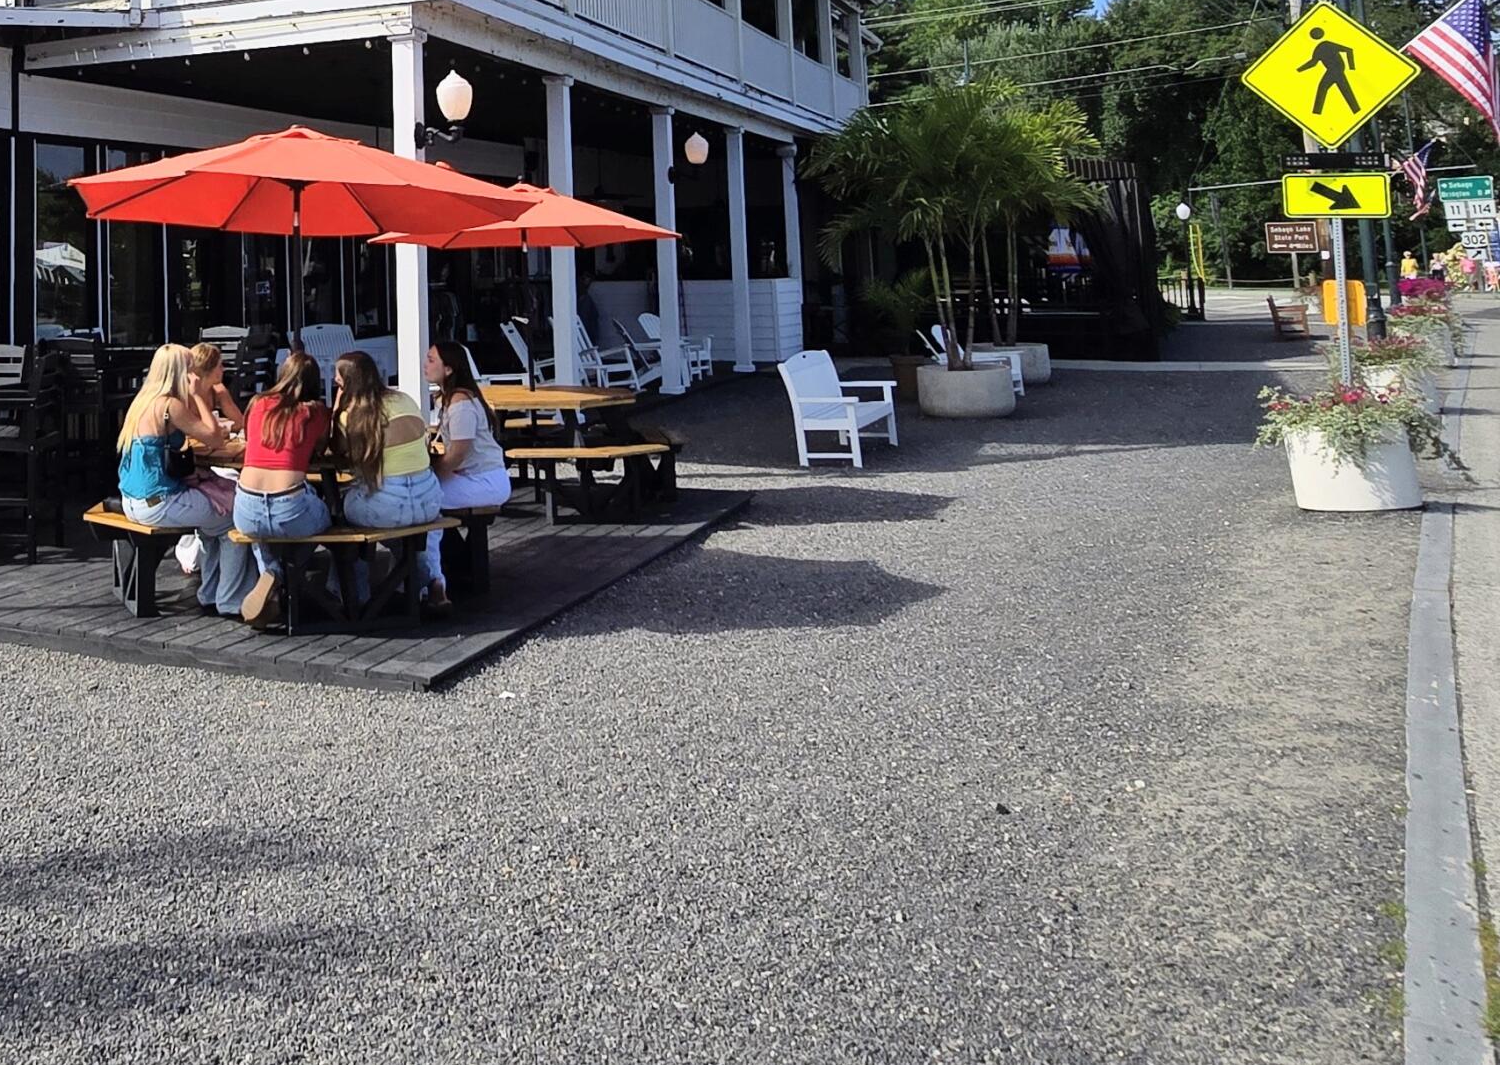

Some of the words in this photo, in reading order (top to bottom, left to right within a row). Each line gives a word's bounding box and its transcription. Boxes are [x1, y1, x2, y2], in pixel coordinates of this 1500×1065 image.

[1450, 205, 1460, 215] 11
[1472, 204, 1491, 214] 114
[1463, 234, 1486, 246] 302
